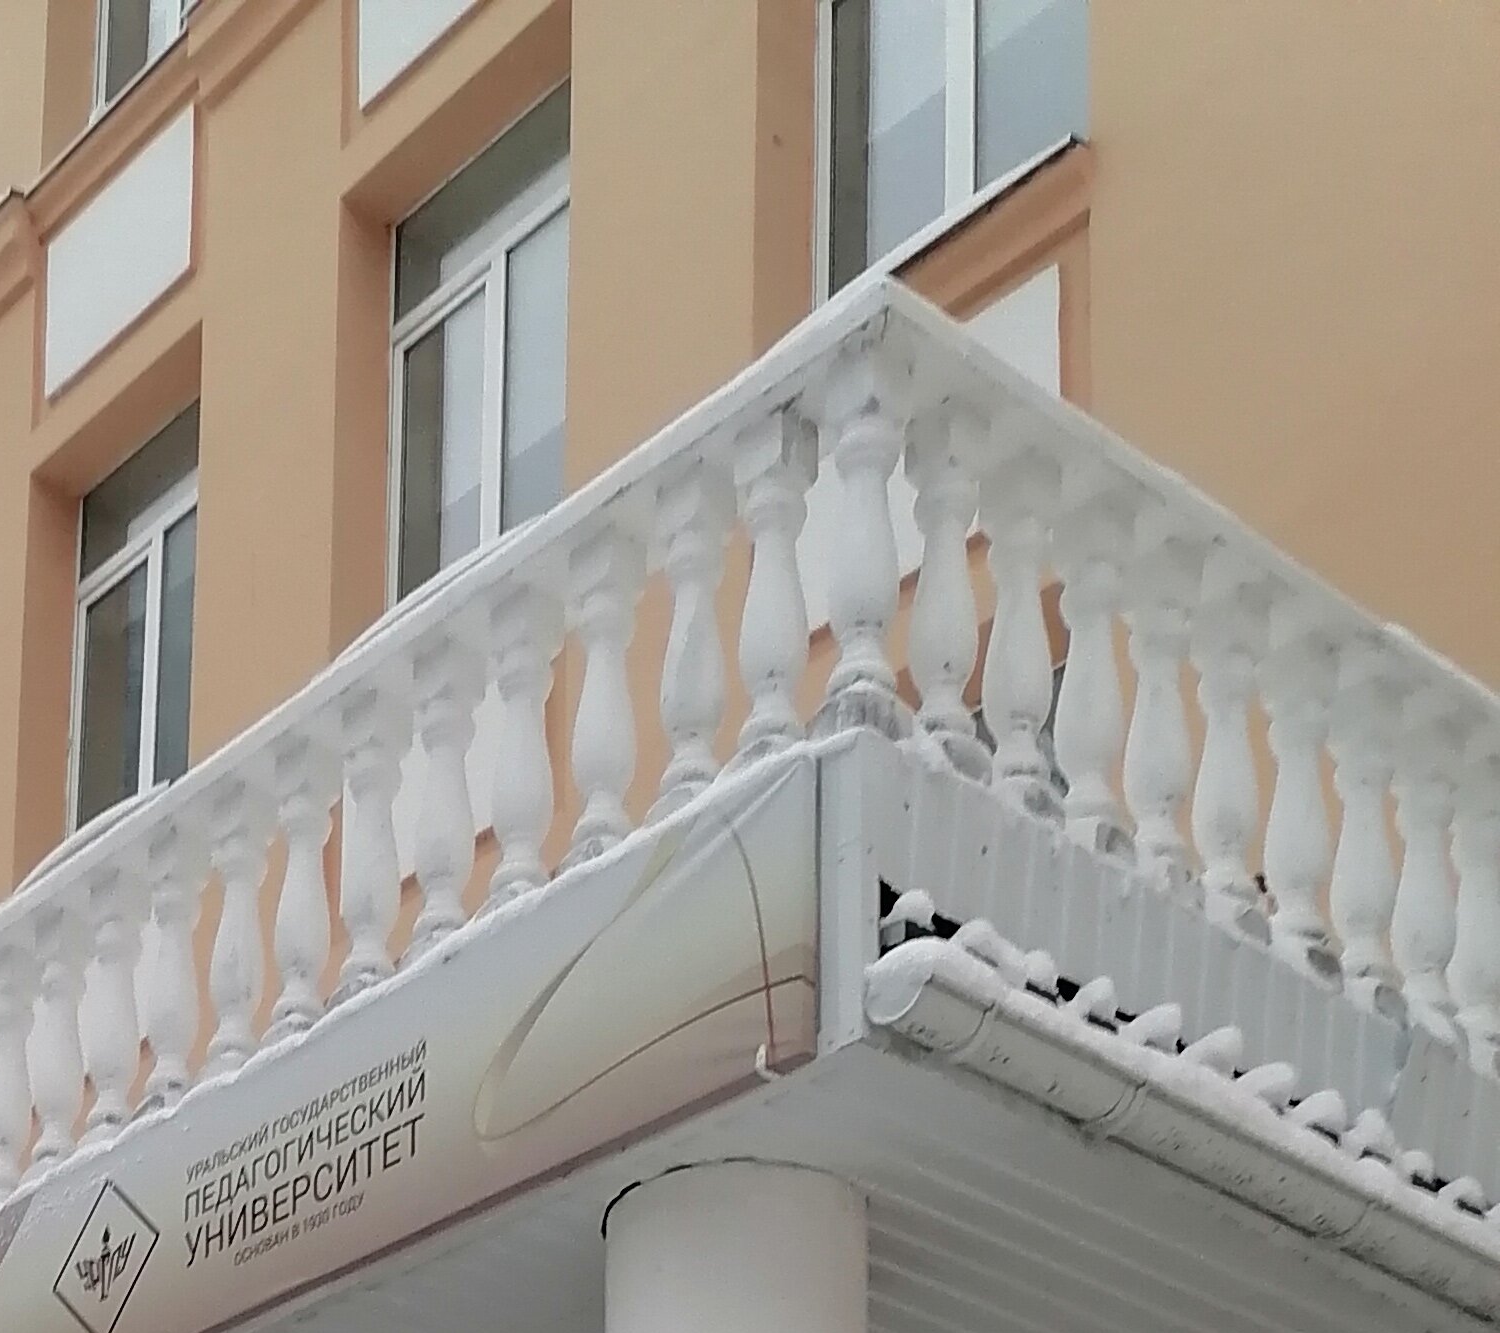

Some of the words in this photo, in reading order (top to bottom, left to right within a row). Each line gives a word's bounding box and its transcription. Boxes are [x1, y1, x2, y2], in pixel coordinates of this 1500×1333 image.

[184, 1064, 426, 1223] ПЕДАГОГИЧЕСКИЙ
[186, 1121, 269, 1185] УРАЛЬСКИЙ
[271, 1036, 427, 1141] ГОСУДАРСТВЕННЫЙ
[185, 1112, 425, 1268] УНИВЕРСИТЕТ
